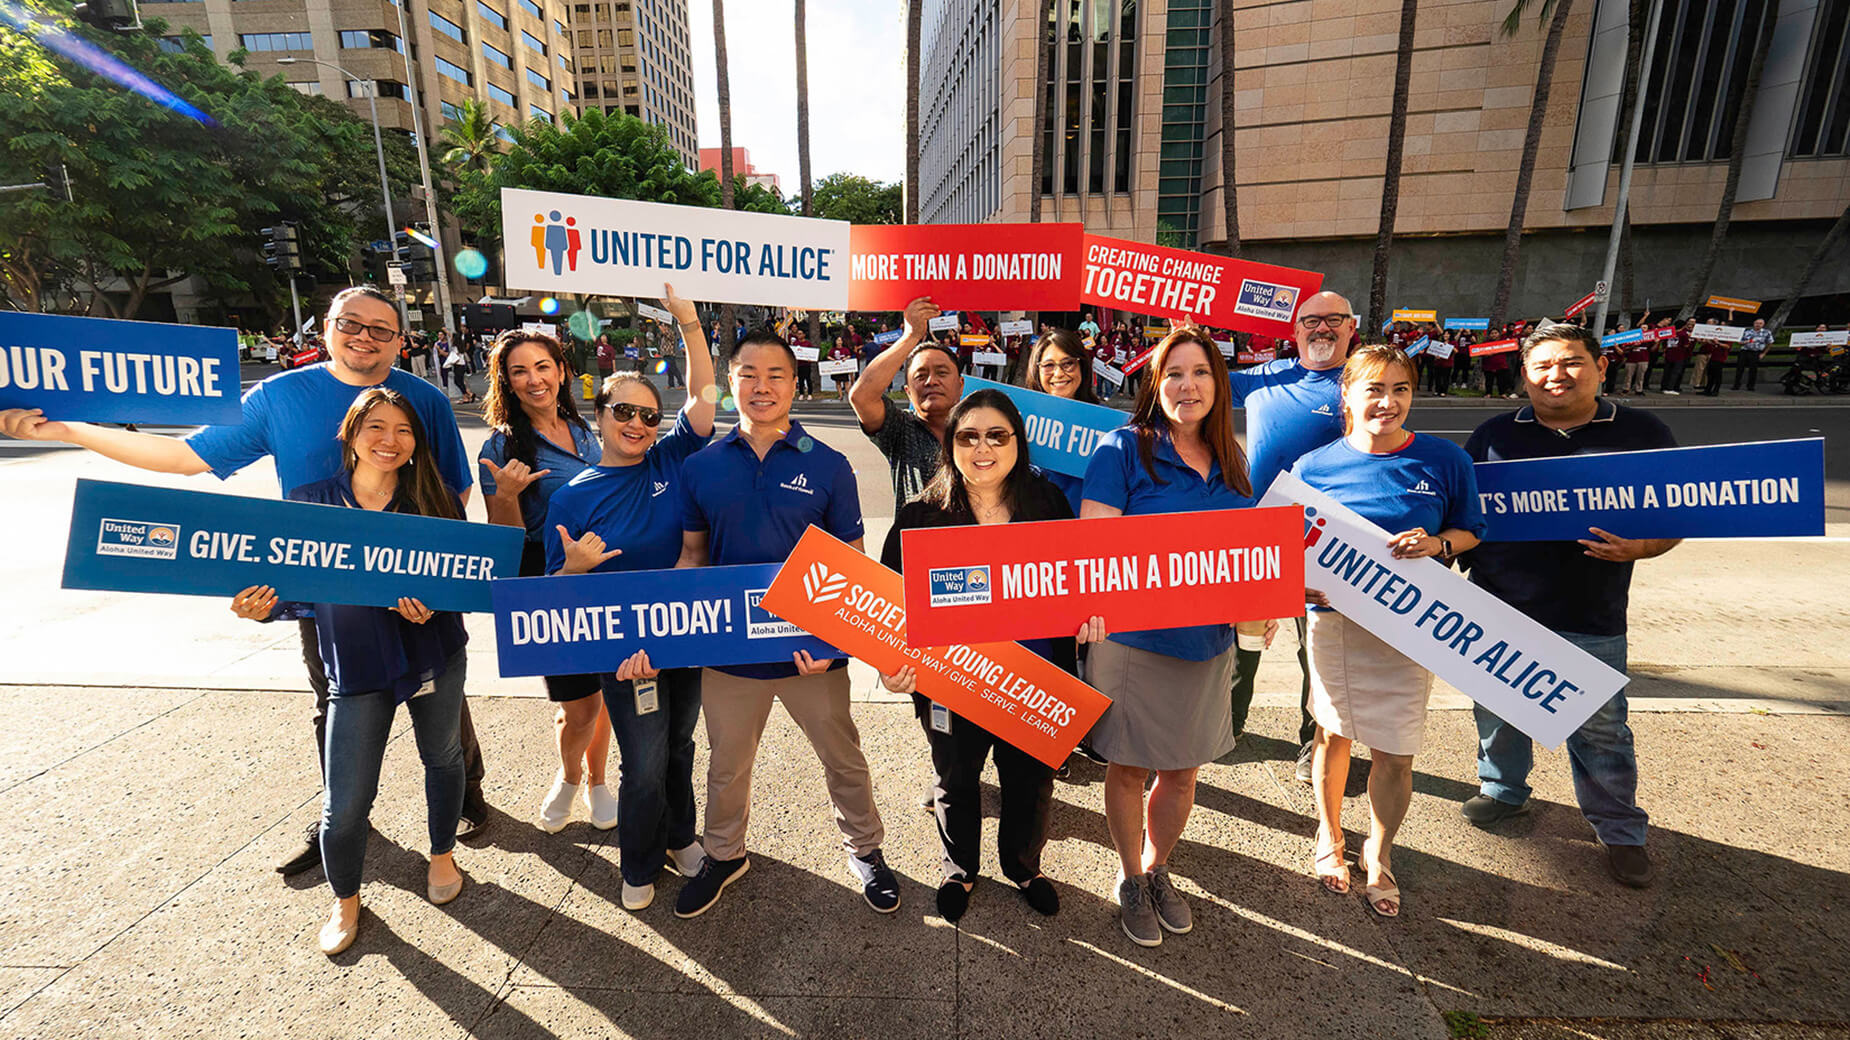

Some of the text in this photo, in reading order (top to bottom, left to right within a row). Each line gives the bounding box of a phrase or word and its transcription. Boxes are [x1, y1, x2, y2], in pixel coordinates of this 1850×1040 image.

[591, 228, 831, 281] UNITED FOR ALICE
[852, 253, 1062, 281] MORE THAN A DONATION
[1088, 244, 1224, 284] CREATING CHANGE
[1084, 264, 1216, 316] TOGETHER
[1244, 283, 1274, 296] United
[1253, 294, 1271, 307] Way
[80, 350, 223, 398] FUTURE
[1025, 414, 1064, 450] OUR
[1511, 489, 1568, 513] MORE
[1573, 485, 1636, 511] THAN
[1643, 484, 1660, 509] A
[1666, 477, 1799, 507] DONATION
[105, 522, 146, 535] United
[120, 533, 144, 546] Way
[189, 529, 498, 581] GIVE. SERVE. VOLUNTEER.
[1001, 546, 1281, 599] MORE THAN A DONATION
[932, 571, 964, 583] United
[945, 581, 964, 592] Way
[511, 599, 734, 646] DONATE TODAY!
[751, 626, 776, 635] Aloha
[845, 584, 907, 638] SOCIET
[1317, 537, 1579, 714] UNITED FOR ALICE
[834, 607, 876, 636] ALOHA
[980, 687, 1018, 716] SERVE.
[1020, 710, 1061, 740] LEARN.
[943, 643, 1077, 728] YOUNG LEADERS
